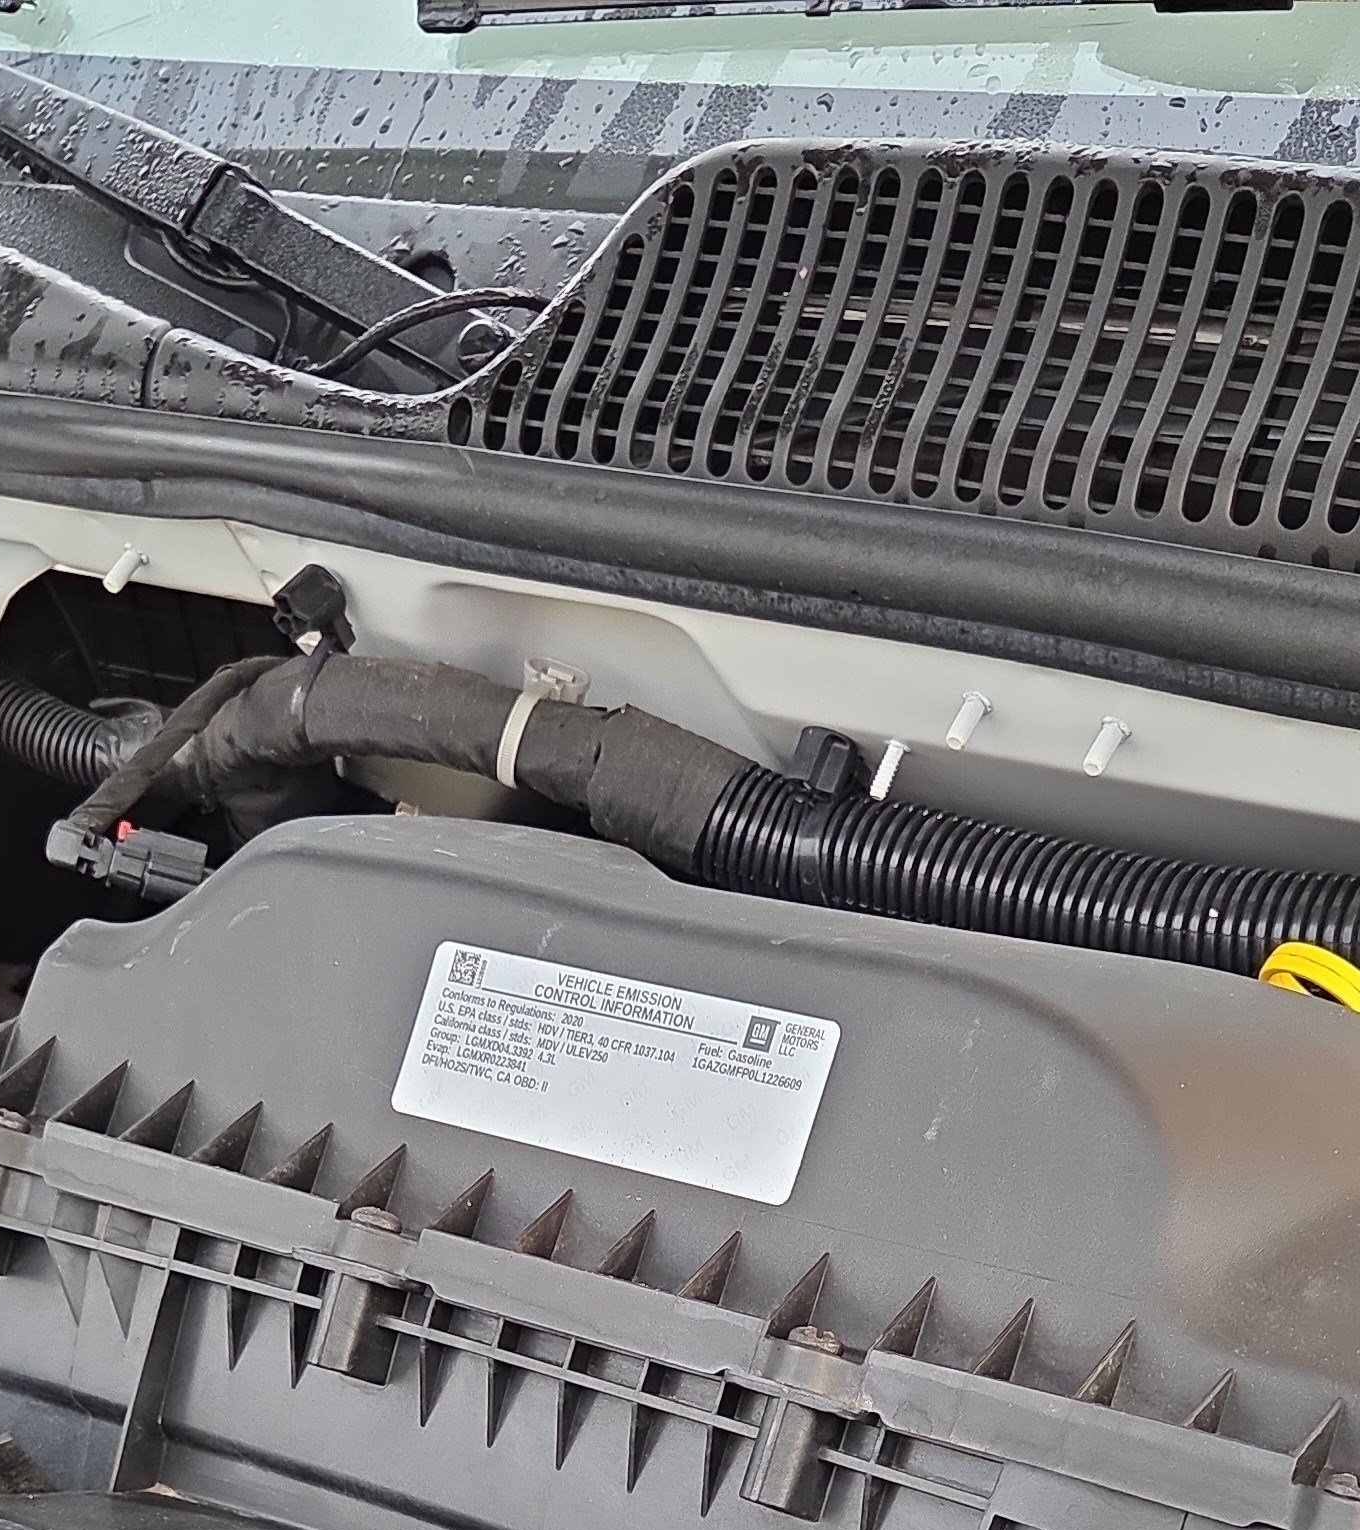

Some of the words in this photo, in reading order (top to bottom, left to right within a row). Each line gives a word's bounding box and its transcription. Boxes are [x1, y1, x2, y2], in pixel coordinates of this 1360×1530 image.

[441, 986, 485, 1006] Conforms
[485, 996, 497, 1008] to
[497, 998, 556, 1021] Regulations:
[560, 1012, 584, 1028] 2020
[533, 983, 596, 1009] CONTROL
[599, 998, 695, 1030] INFORMATION
[557, 972, 614, 996] VEHICLE
[615, 985, 682, 1011] EMISSION
[425, 1038, 451, 1056] Evap:
[429, 1026, 461, 1044] Group:
[536, 1050, 556, 1066] 4.3L
[433, 1013, 477, 1033] California
[477, 1023, 502, 1039] class
[507, 1031, 533, 1046] stds:
[535, 1036, 560, 1052] MDV
[565, 1042, 609, 1063] ULEV250
[437, 999, 456, 1015] U.S.
[456, 1004, 476, 1019] EPA
[477, 1009, 502, 1024] class
[507, 1017, 533, 1031] stds:
[536, 1021, 560, 1037] HDV
[565, 1028, 594, 1046] TIER3,
[596, 1035, 610, 1048] 40
[605, 1038, 632, 1054] CFR
[632, 1043, 676, 1063] 1037.104
[780, 1032, 819, 1051] MOTORS
[784, 1022, 825, 1041] GENERAL
[697, 1041, 723, 1058] Fuel:
[727, 1048, 772, 1069] Gasoline
[777, 1043, 796, 1057] LLC
[495, 1070, 511, 1084] CA
[512, 1074, 540, 1090] OBD:
